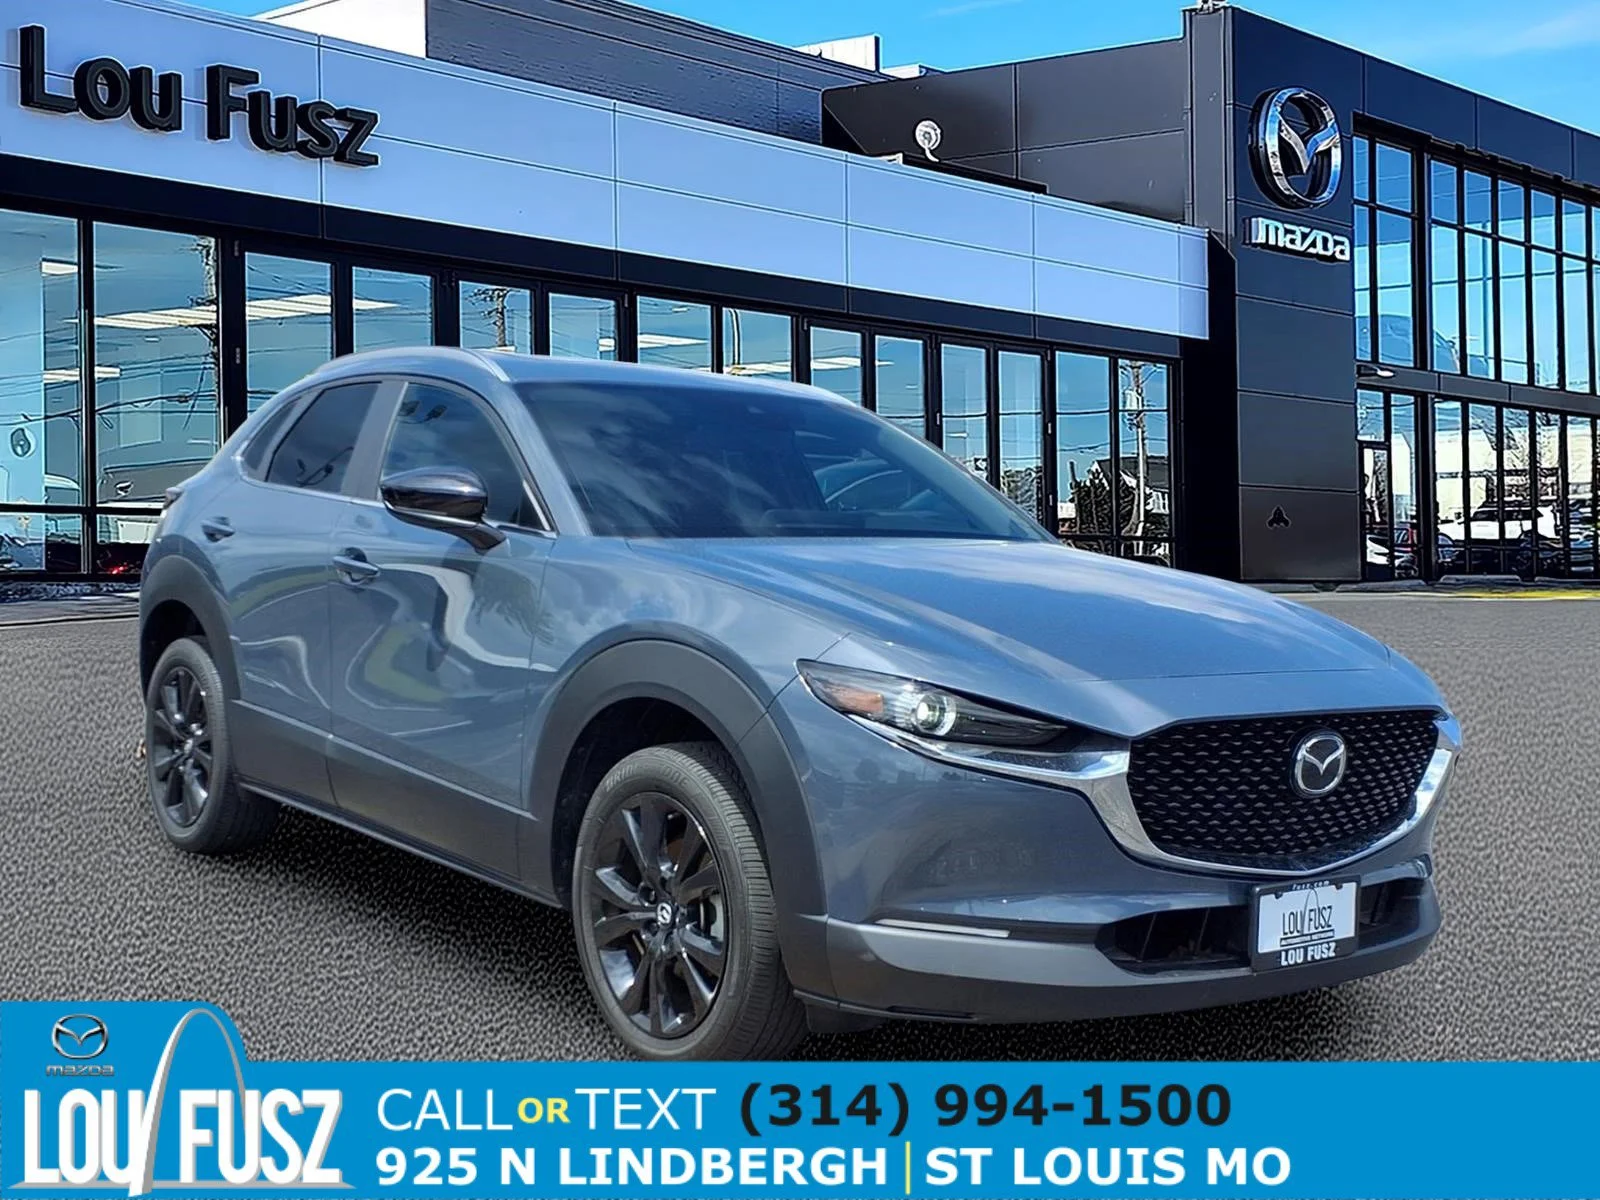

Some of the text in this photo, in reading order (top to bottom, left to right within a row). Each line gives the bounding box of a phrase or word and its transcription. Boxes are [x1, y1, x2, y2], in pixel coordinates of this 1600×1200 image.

[20, 25, 379, 166] Lou Fusz
[1282, 905, 1332, 936] LOU FUSZ
[1281, 942, 1336, 966] LOU FUSZ
